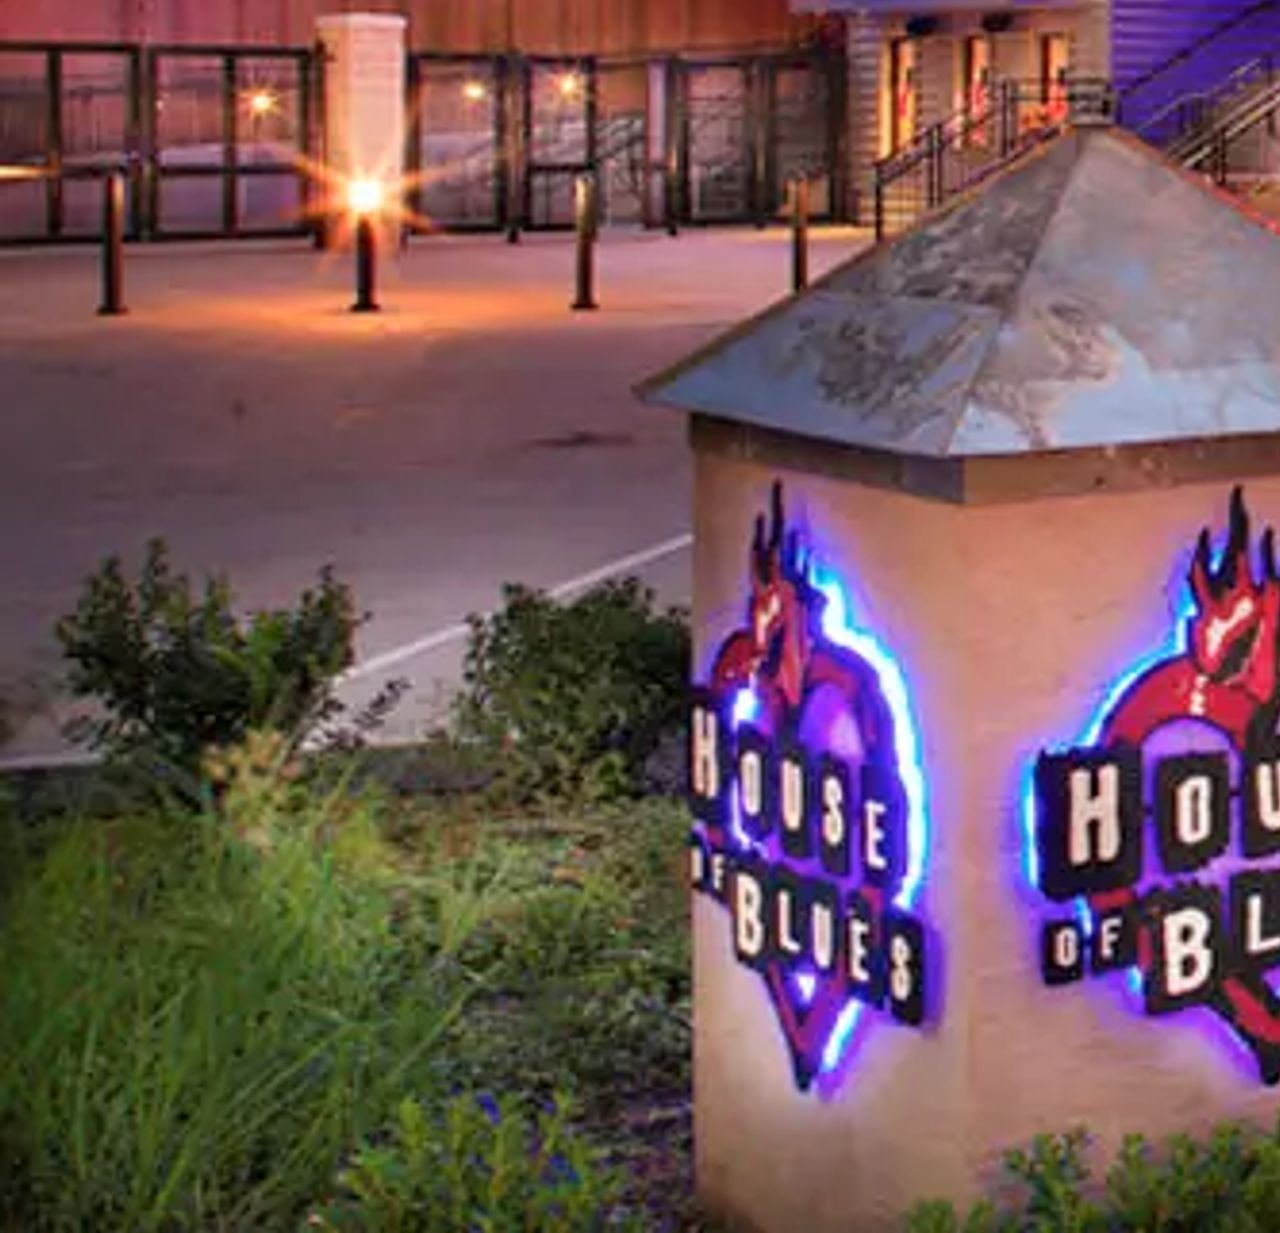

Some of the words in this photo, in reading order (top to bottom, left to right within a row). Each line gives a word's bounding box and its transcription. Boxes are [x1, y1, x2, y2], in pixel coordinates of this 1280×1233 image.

[692, 704, 889, 870] HOUSE
[736, 871, 913, 1002] BLUES
[1053, 916, 1123, 970] OF
